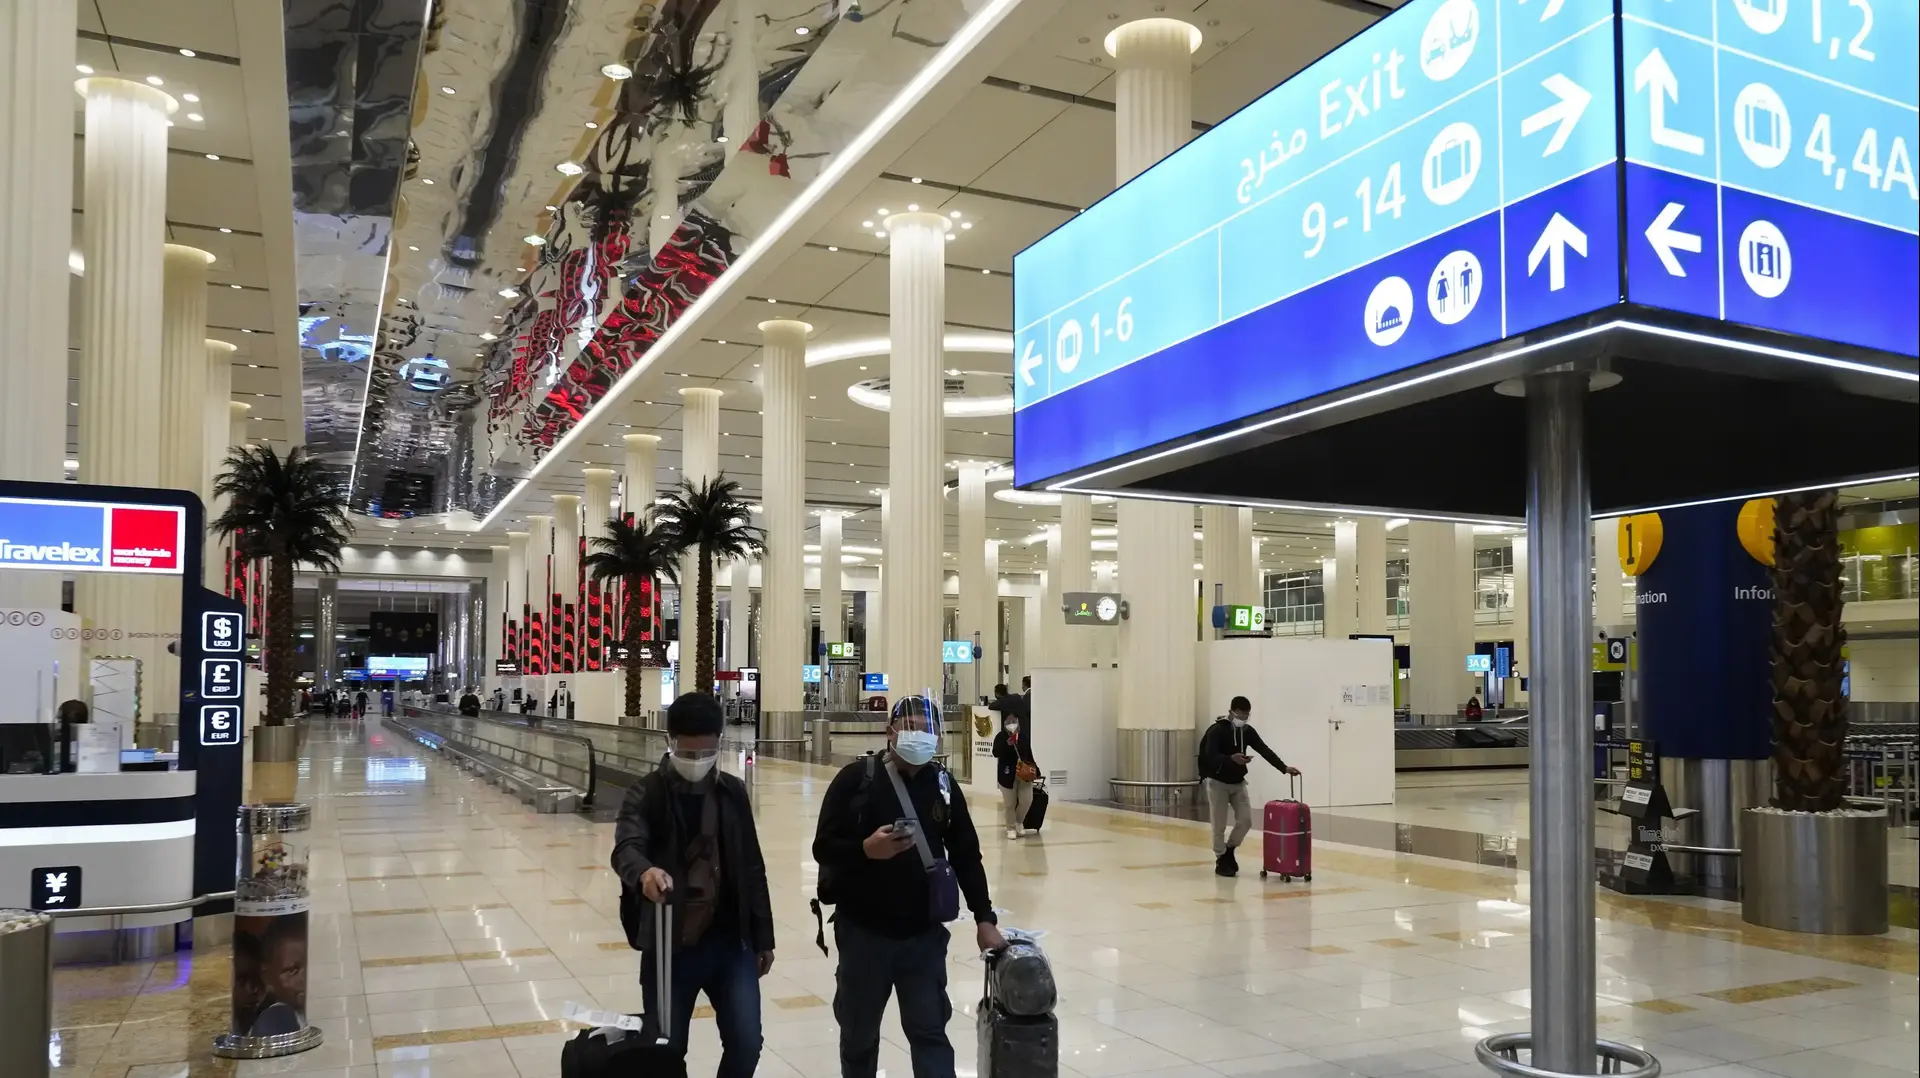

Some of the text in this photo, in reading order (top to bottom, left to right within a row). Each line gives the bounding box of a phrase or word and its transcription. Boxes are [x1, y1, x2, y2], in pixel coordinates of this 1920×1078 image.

[1811, 0, 1875, 62] 1,2
[1320, 47, 1406, 140] Exit
[1237, 128, 1307, 203] مخرج
[1804, 113, 1919, 200] 4,4A
[1090, 296, 1134, 355] 1-6
[1636, 590, 1668, 604] ation
[211, 732, 229, 740] EUR
